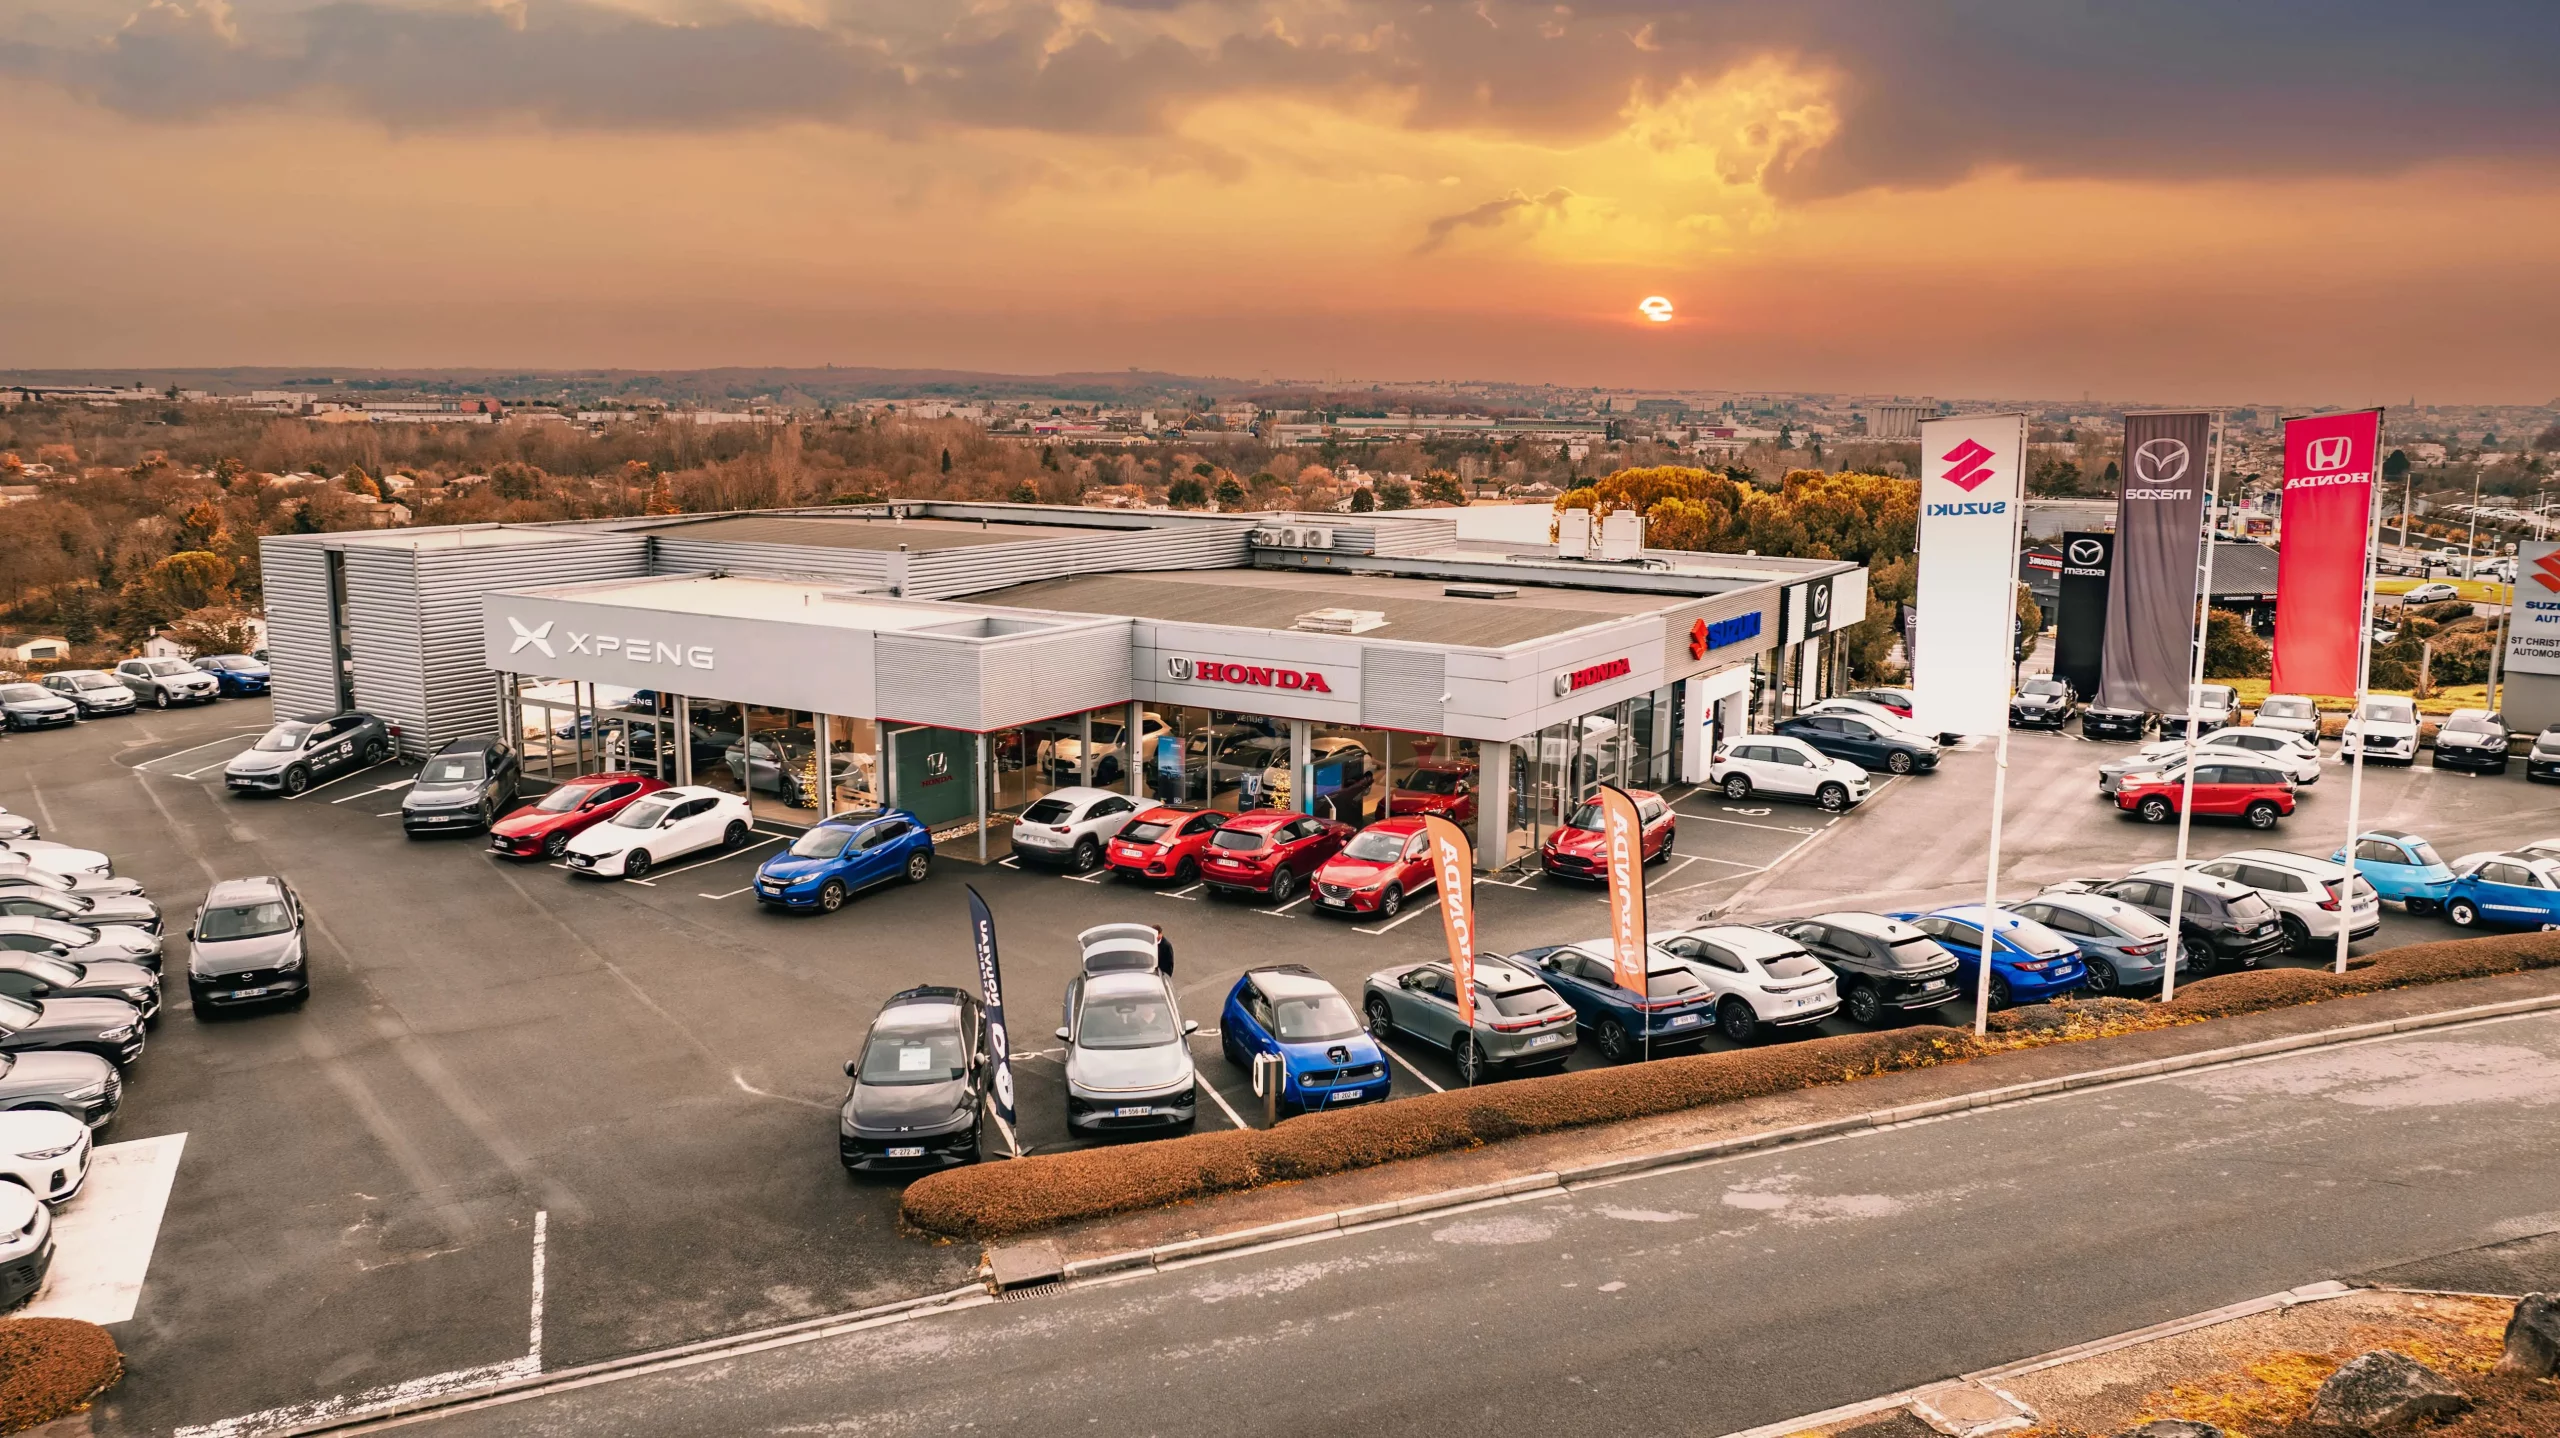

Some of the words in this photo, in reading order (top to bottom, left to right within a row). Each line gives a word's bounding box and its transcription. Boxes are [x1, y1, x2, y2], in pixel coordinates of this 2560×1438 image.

[2064, 567, 2106, 576] mazda
[2525, 601, 2560, 610] SUZ
[1707, 611, 1761, 651] SUZUKI
[2511, 636, 2523, 645] ST
[567, 631, 715, 670] XPENG
[1195, 661, 1331, 692] HONDA
[1570, 658, 1631, 690] HONDA
[921, 775, 953, 788] HONDA
[889, 1147, 921, 1157] HC-272-JV
